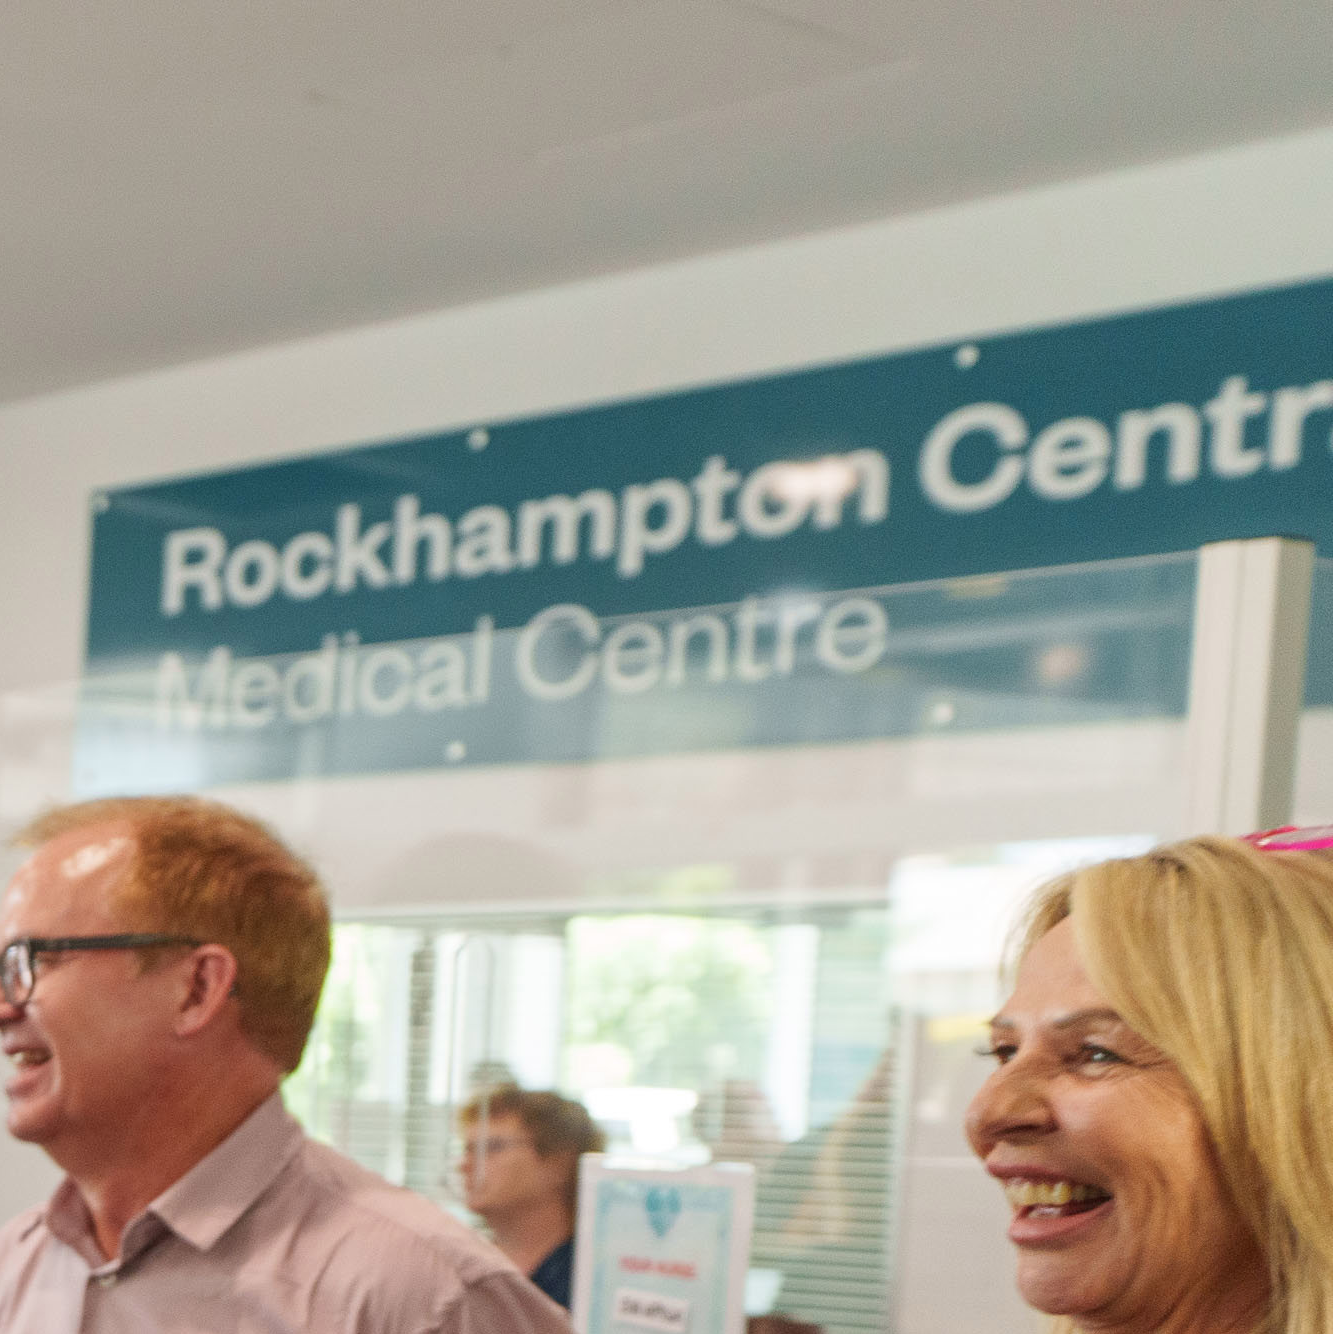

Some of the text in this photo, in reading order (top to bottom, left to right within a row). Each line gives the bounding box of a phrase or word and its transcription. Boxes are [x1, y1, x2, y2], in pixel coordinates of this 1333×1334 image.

[161, 374, 1333, 616] Rockhampton Centr
[155, 597, 890, 732] Medical Centre
